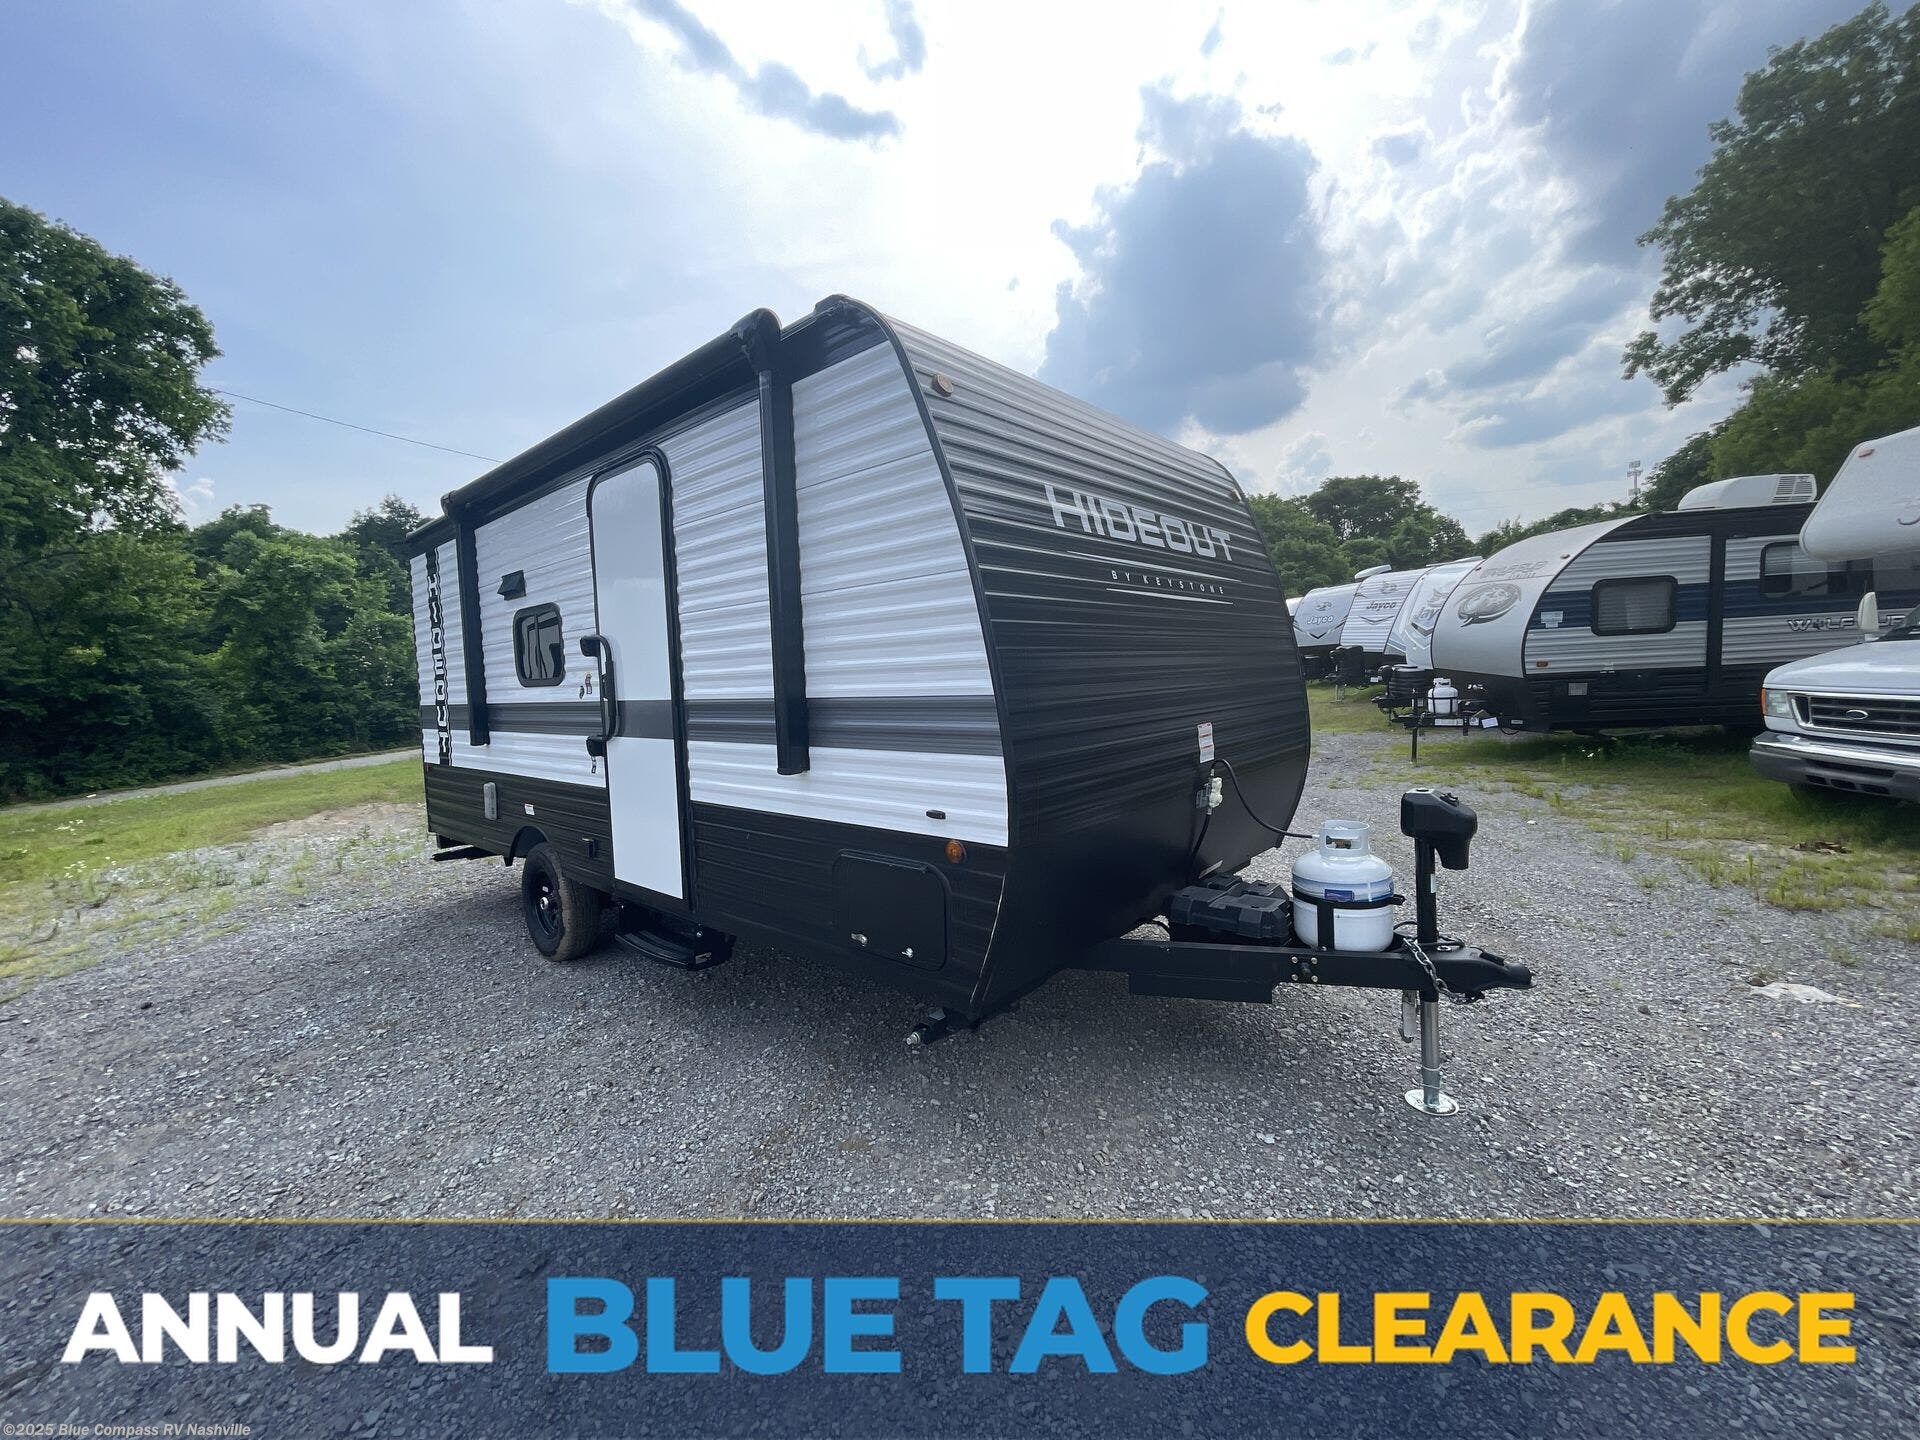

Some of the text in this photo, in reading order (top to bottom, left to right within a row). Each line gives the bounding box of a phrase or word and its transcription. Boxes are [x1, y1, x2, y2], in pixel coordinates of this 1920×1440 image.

[1044, 484, 1233, 561] HIDEOUT
[1111, 570, 1225, 595] BY KEYSTONE
[1366, 600, 1397, 611] Jayco
[1306, 615, 1334, 625] Jayco
[427, 573, 449, 753] HIDEOUT
